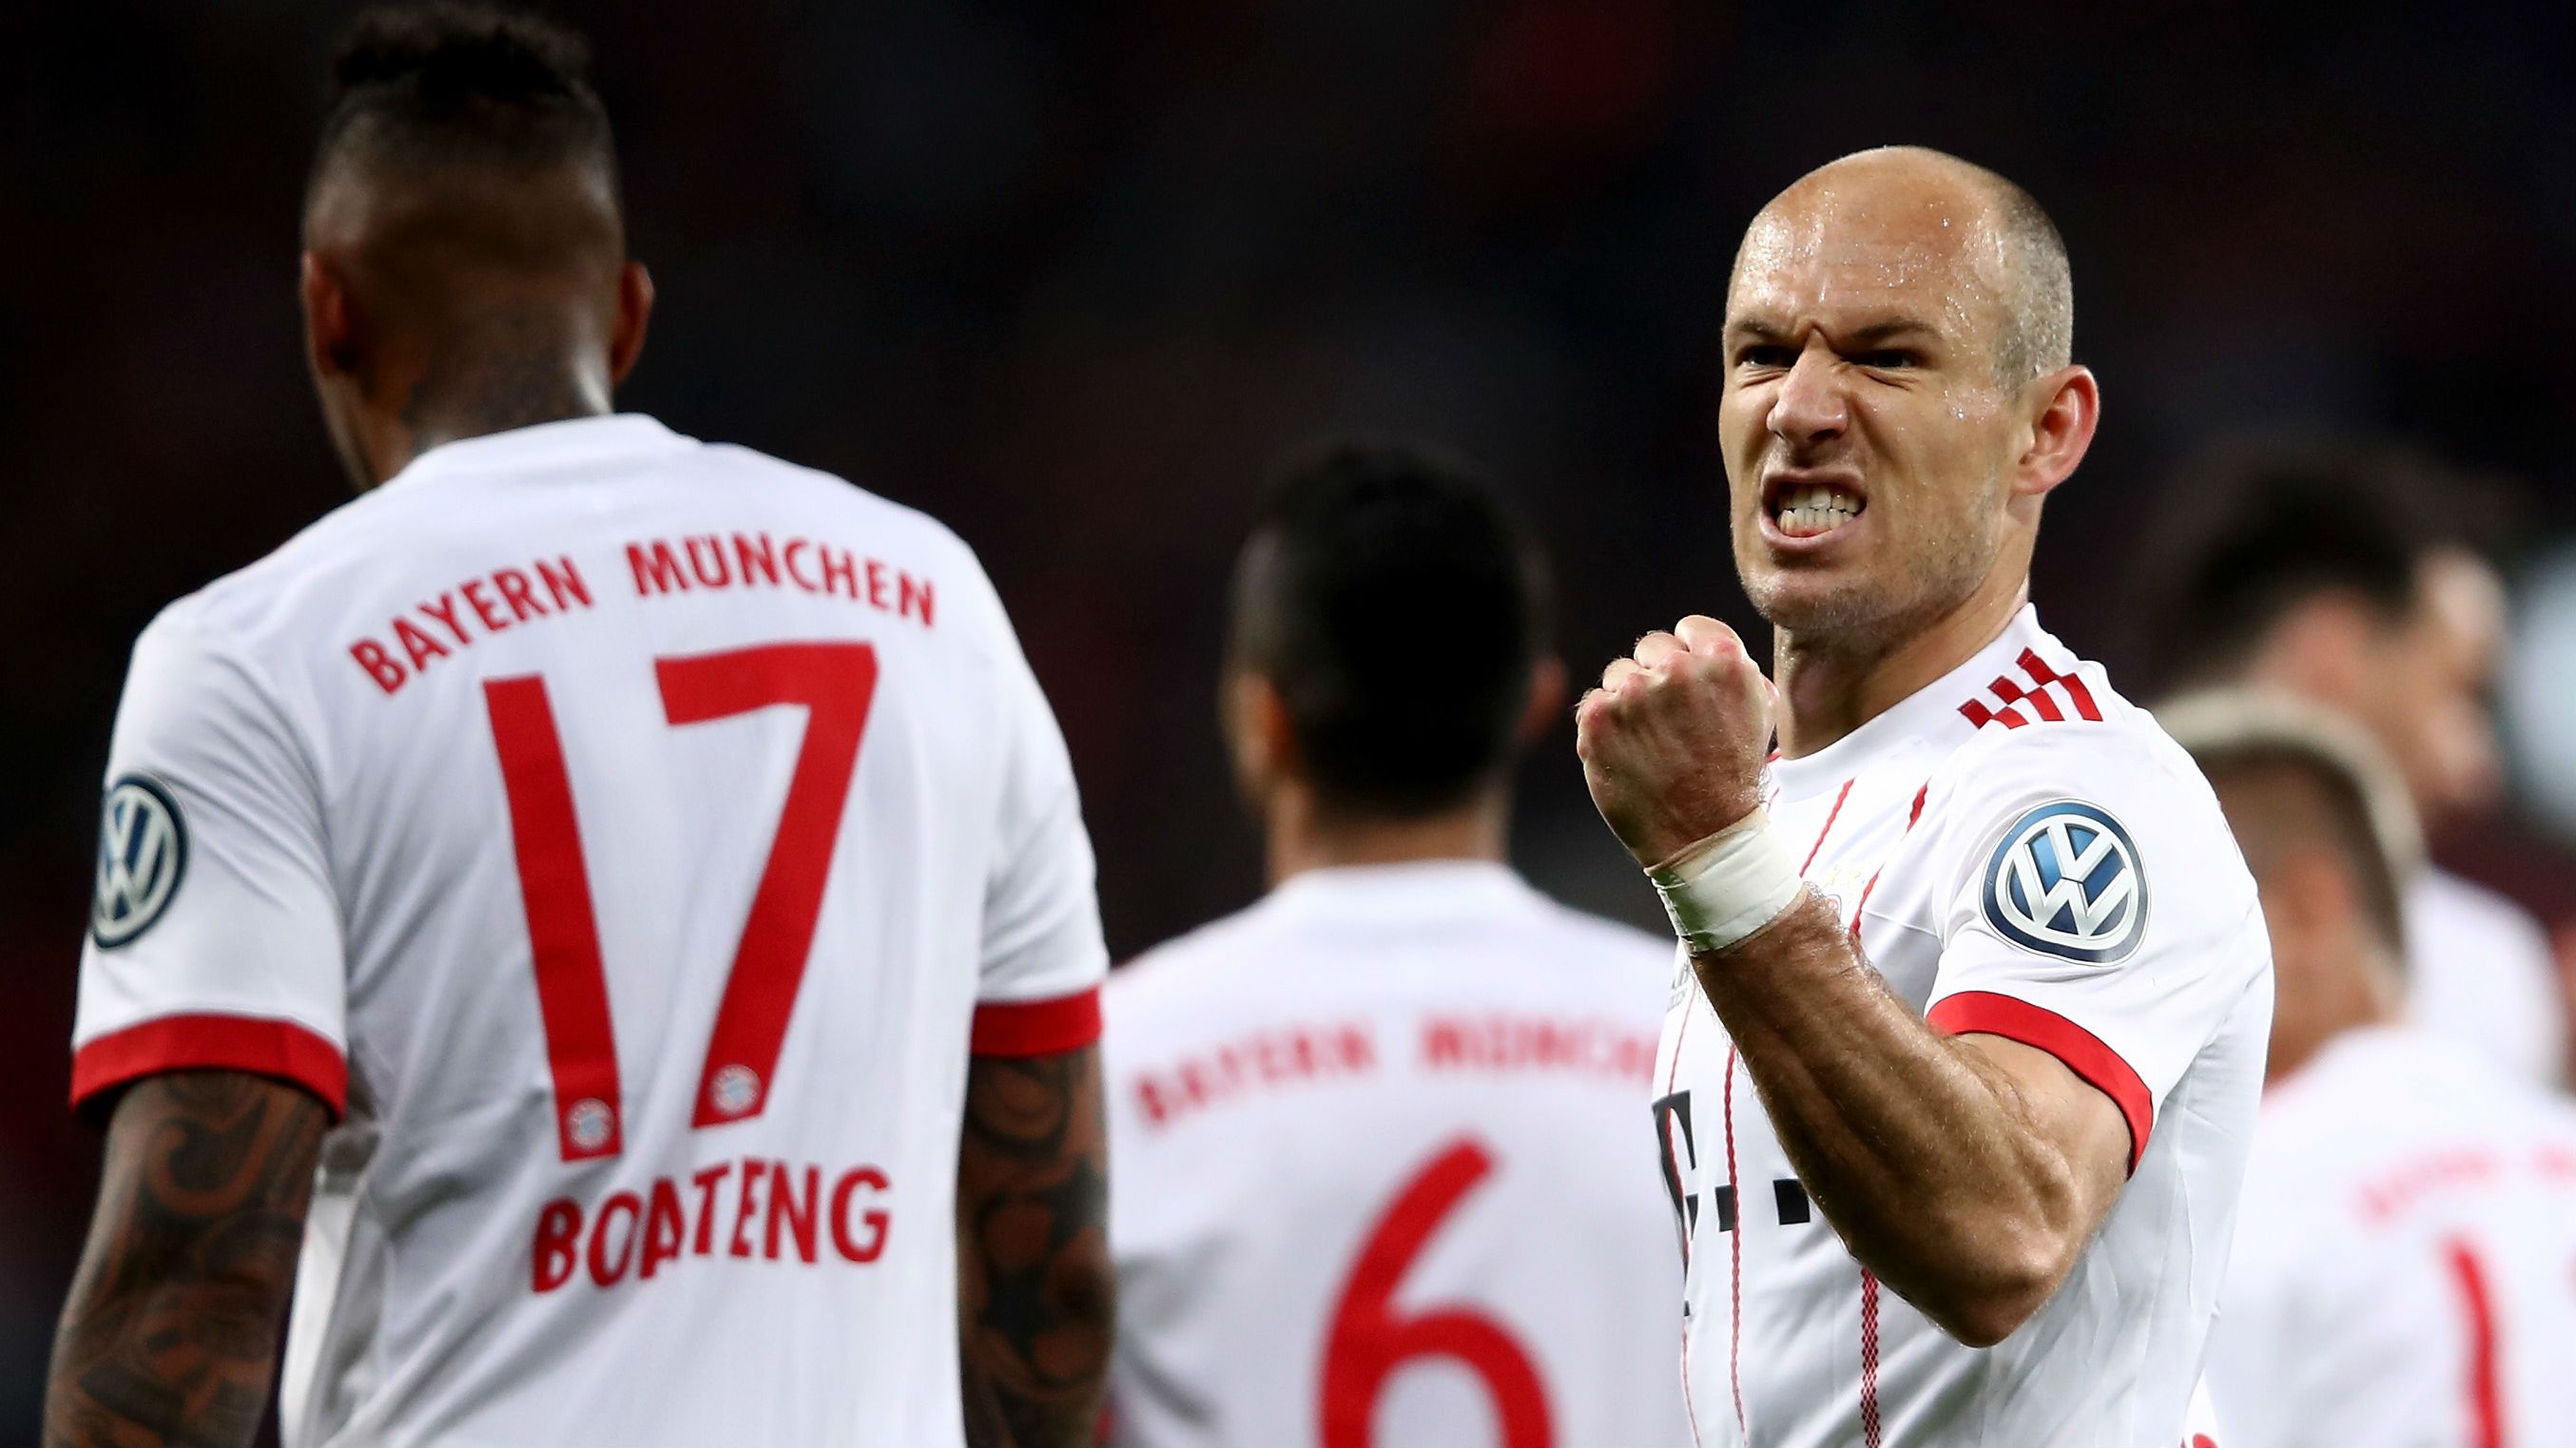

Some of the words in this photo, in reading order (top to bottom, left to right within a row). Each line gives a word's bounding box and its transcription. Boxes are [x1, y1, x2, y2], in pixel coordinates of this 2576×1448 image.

[349, 556, 593, 695] BAYERN
[625, 533, 936, 628] MÜNCHEN
[482, 640, 881, 1162] 17
[1995, 813, 2140, 951] VW
[1133, 1024, 1375, 1129] BAYERN
[1419, 1015, 1656, 1086] MÜNCH
[531, 1155, 891, 1295] BOATENG
[1317, 1137, 1557, 1448] 6
